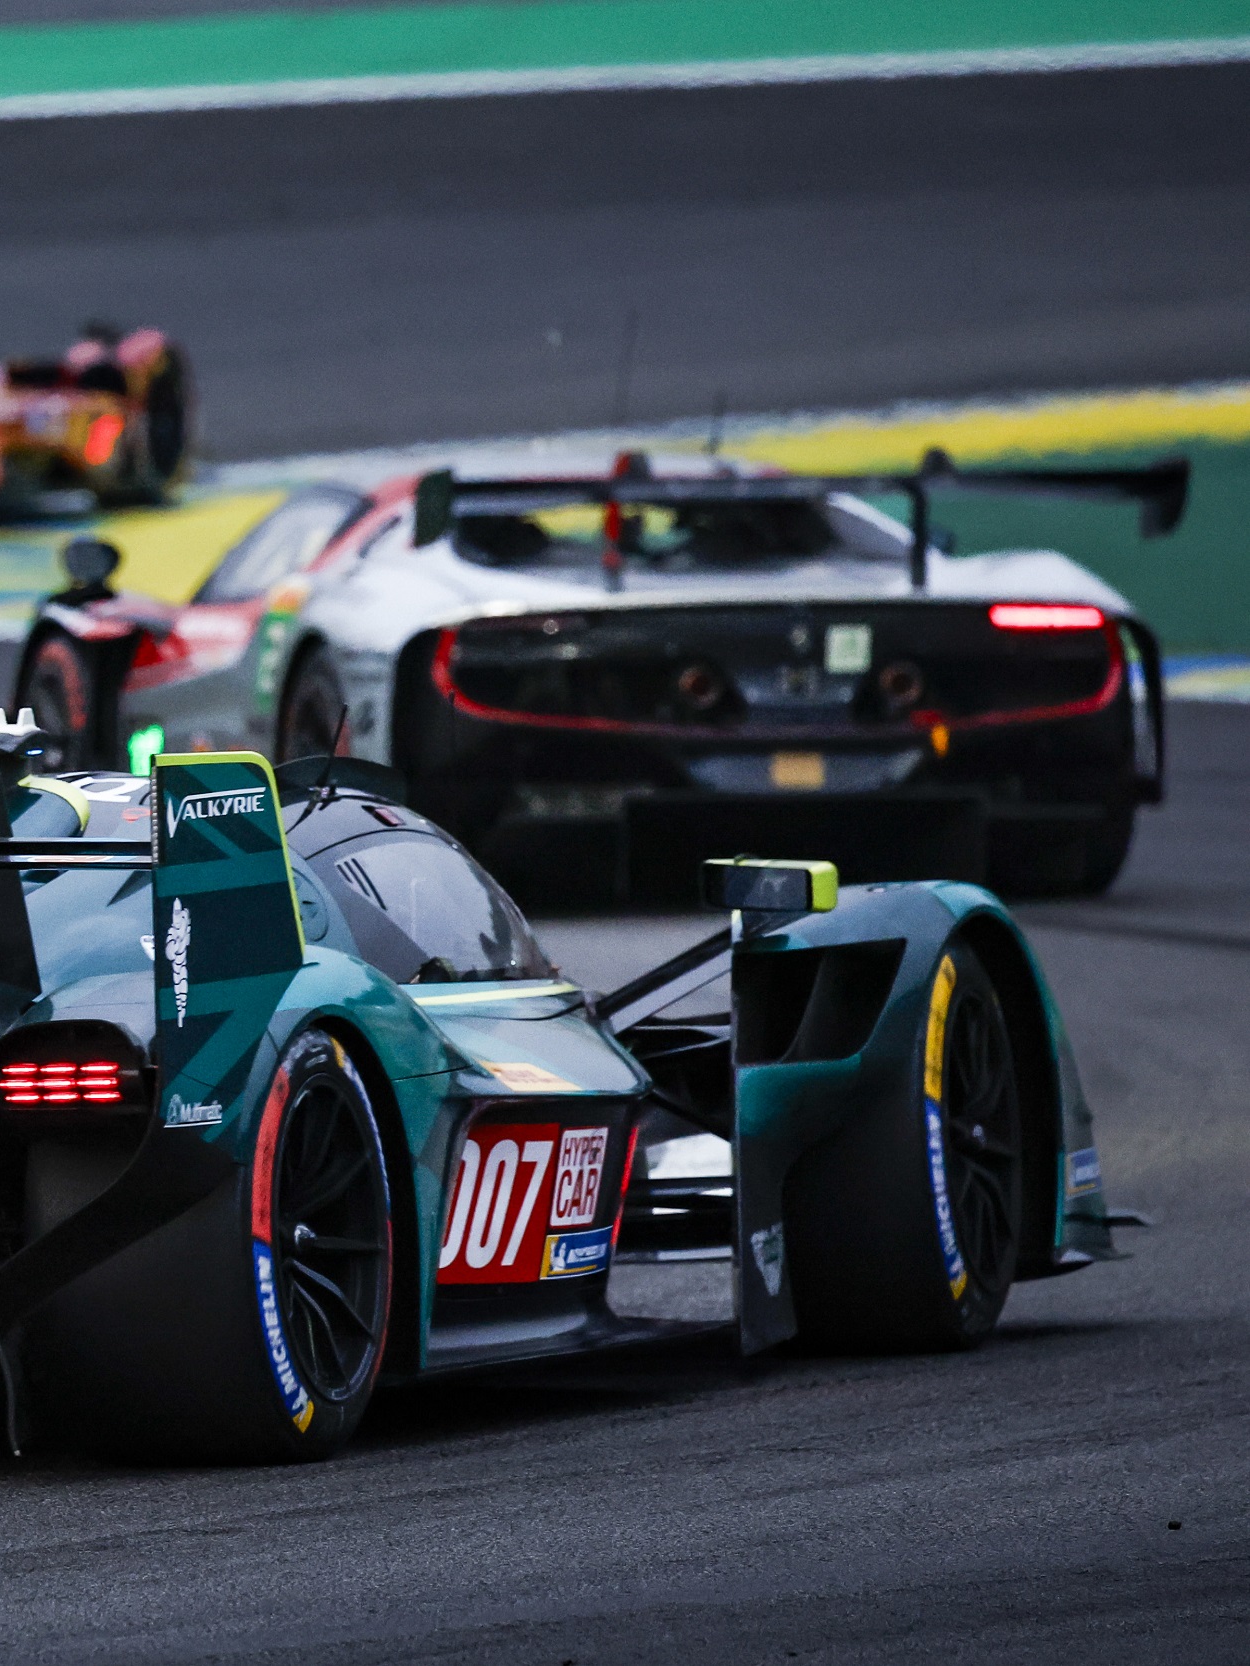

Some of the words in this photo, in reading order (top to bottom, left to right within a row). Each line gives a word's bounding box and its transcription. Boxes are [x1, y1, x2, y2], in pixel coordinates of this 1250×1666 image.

[168, 787, 266, 838] VALKYRIE
[562, 1135, 604, 1167] HYPER
[556, 1168, 599, 1218] CAR
[258, 1255, 297, 1396] MICHELIN
